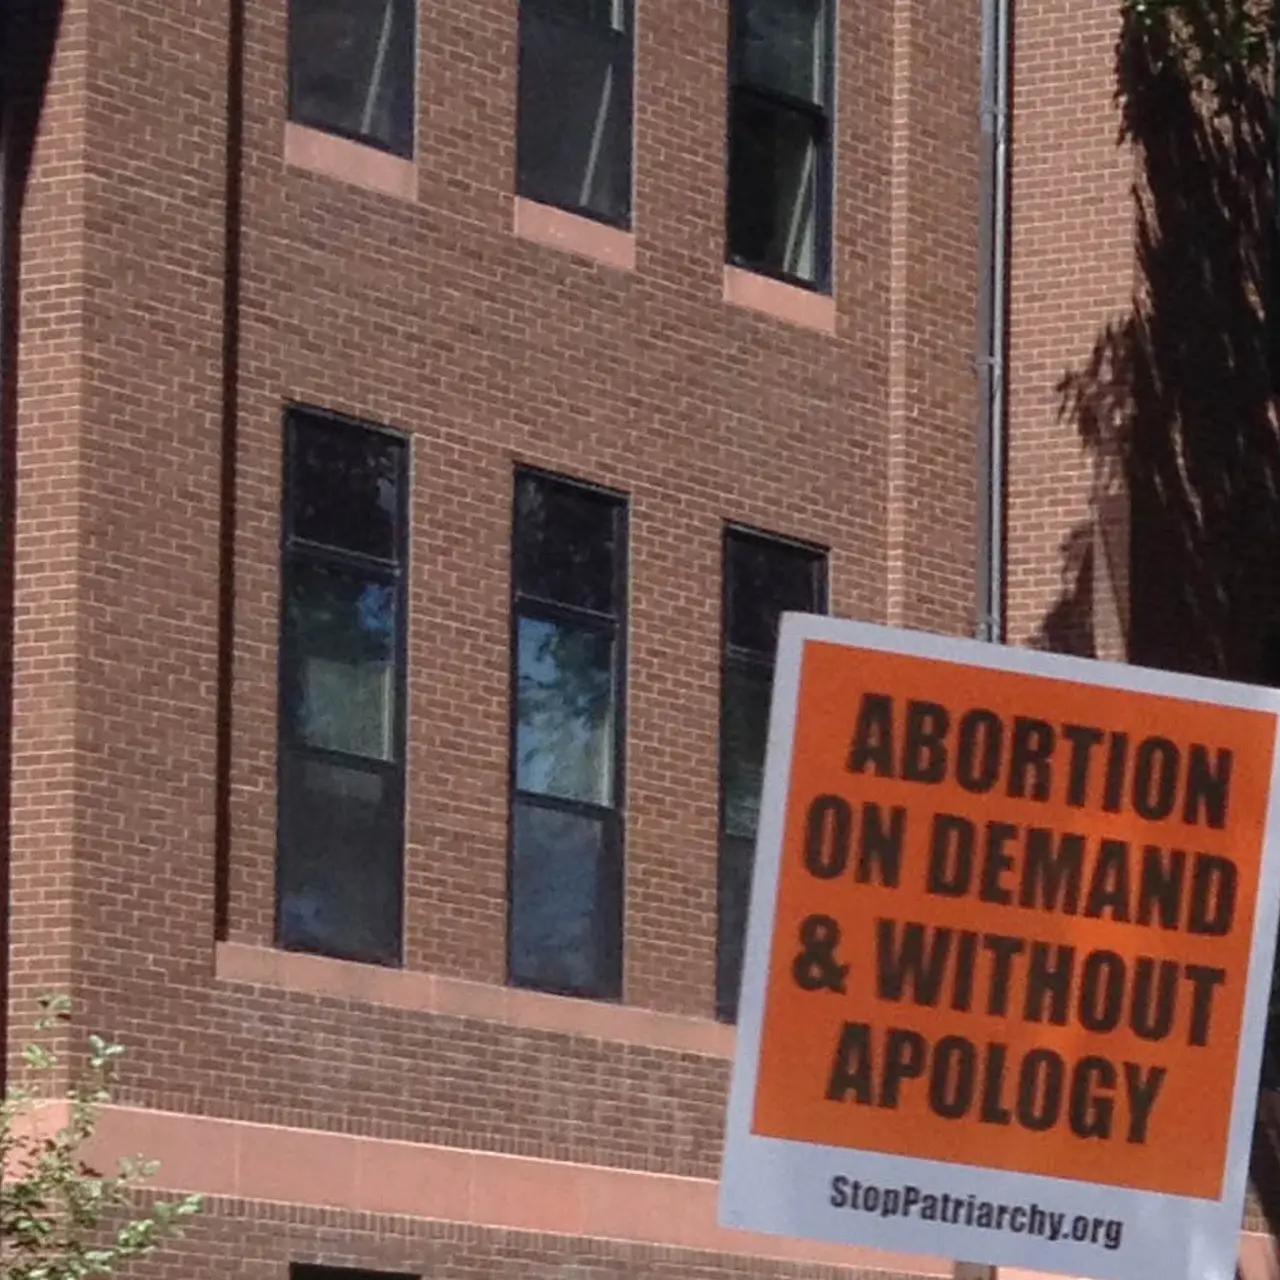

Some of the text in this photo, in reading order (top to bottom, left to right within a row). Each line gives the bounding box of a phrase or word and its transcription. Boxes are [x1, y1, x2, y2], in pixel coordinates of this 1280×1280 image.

[845, 692, 1233, 830] ABORTION
[804, 794, 1239, 937] ON DEMAND
[791, 914, 1225, 1046] & WITHOUT
[825, 1021, 1166, 1145] APOLOGY
[830, 1175, 1124, 1251] StopPatriarchy.org
